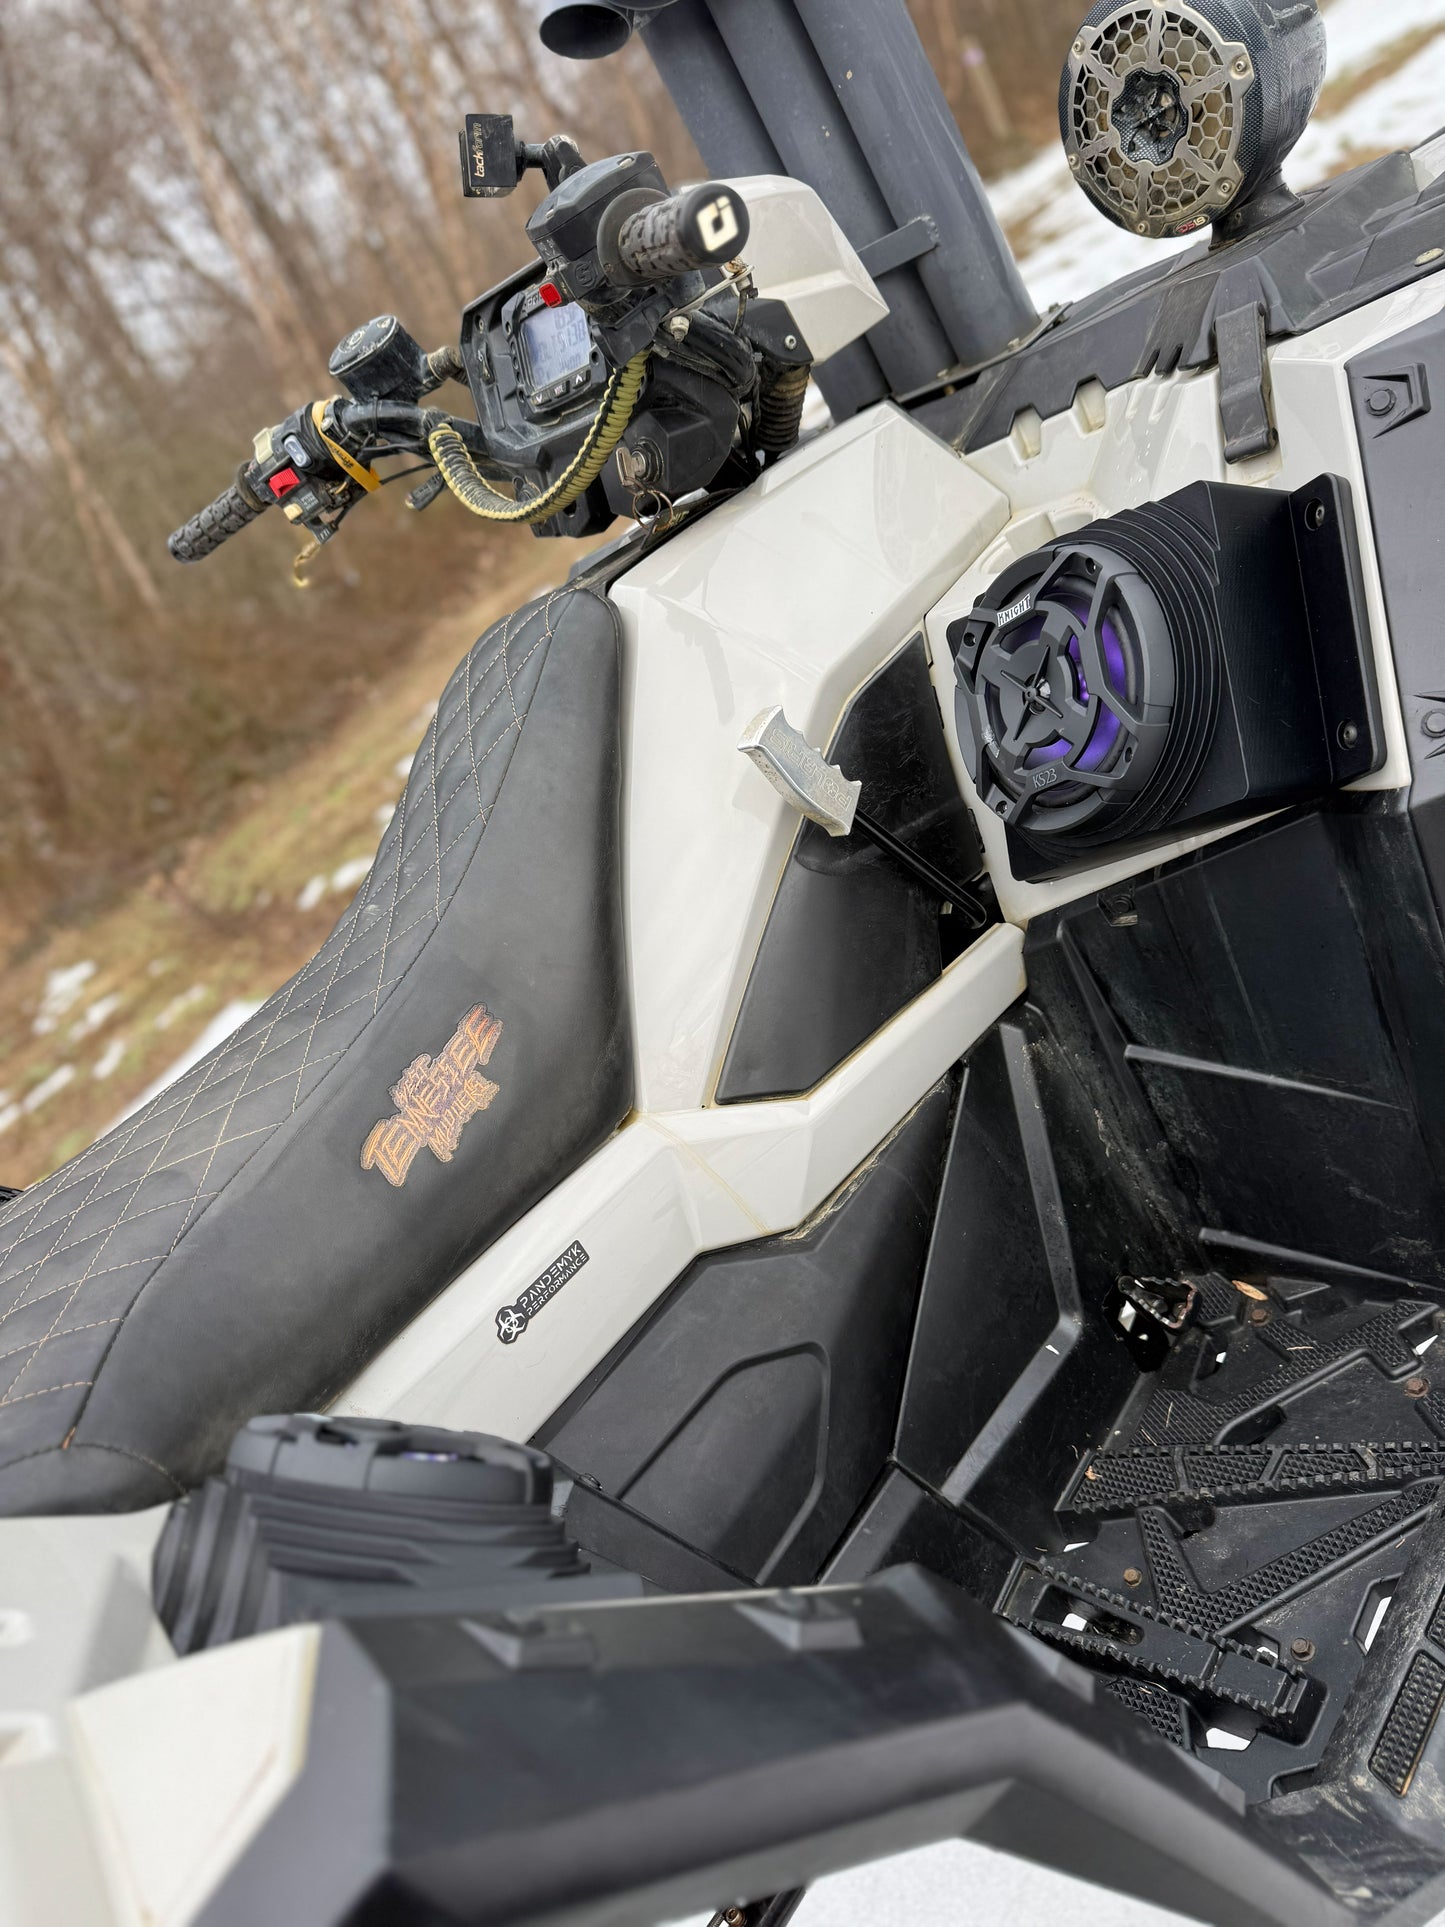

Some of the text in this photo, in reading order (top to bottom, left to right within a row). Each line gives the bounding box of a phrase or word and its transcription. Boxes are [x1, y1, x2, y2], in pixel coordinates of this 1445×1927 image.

[998, 594, 1031, 626] KNIGHT
[1033, 768, 1057, 788] KS23
[363, 1004, 500, 1184] TENNESSEE
[519, 1243, 581, 1308] PANDEMYK
[526, 1253, 587, 1316] PERFORMANCE
